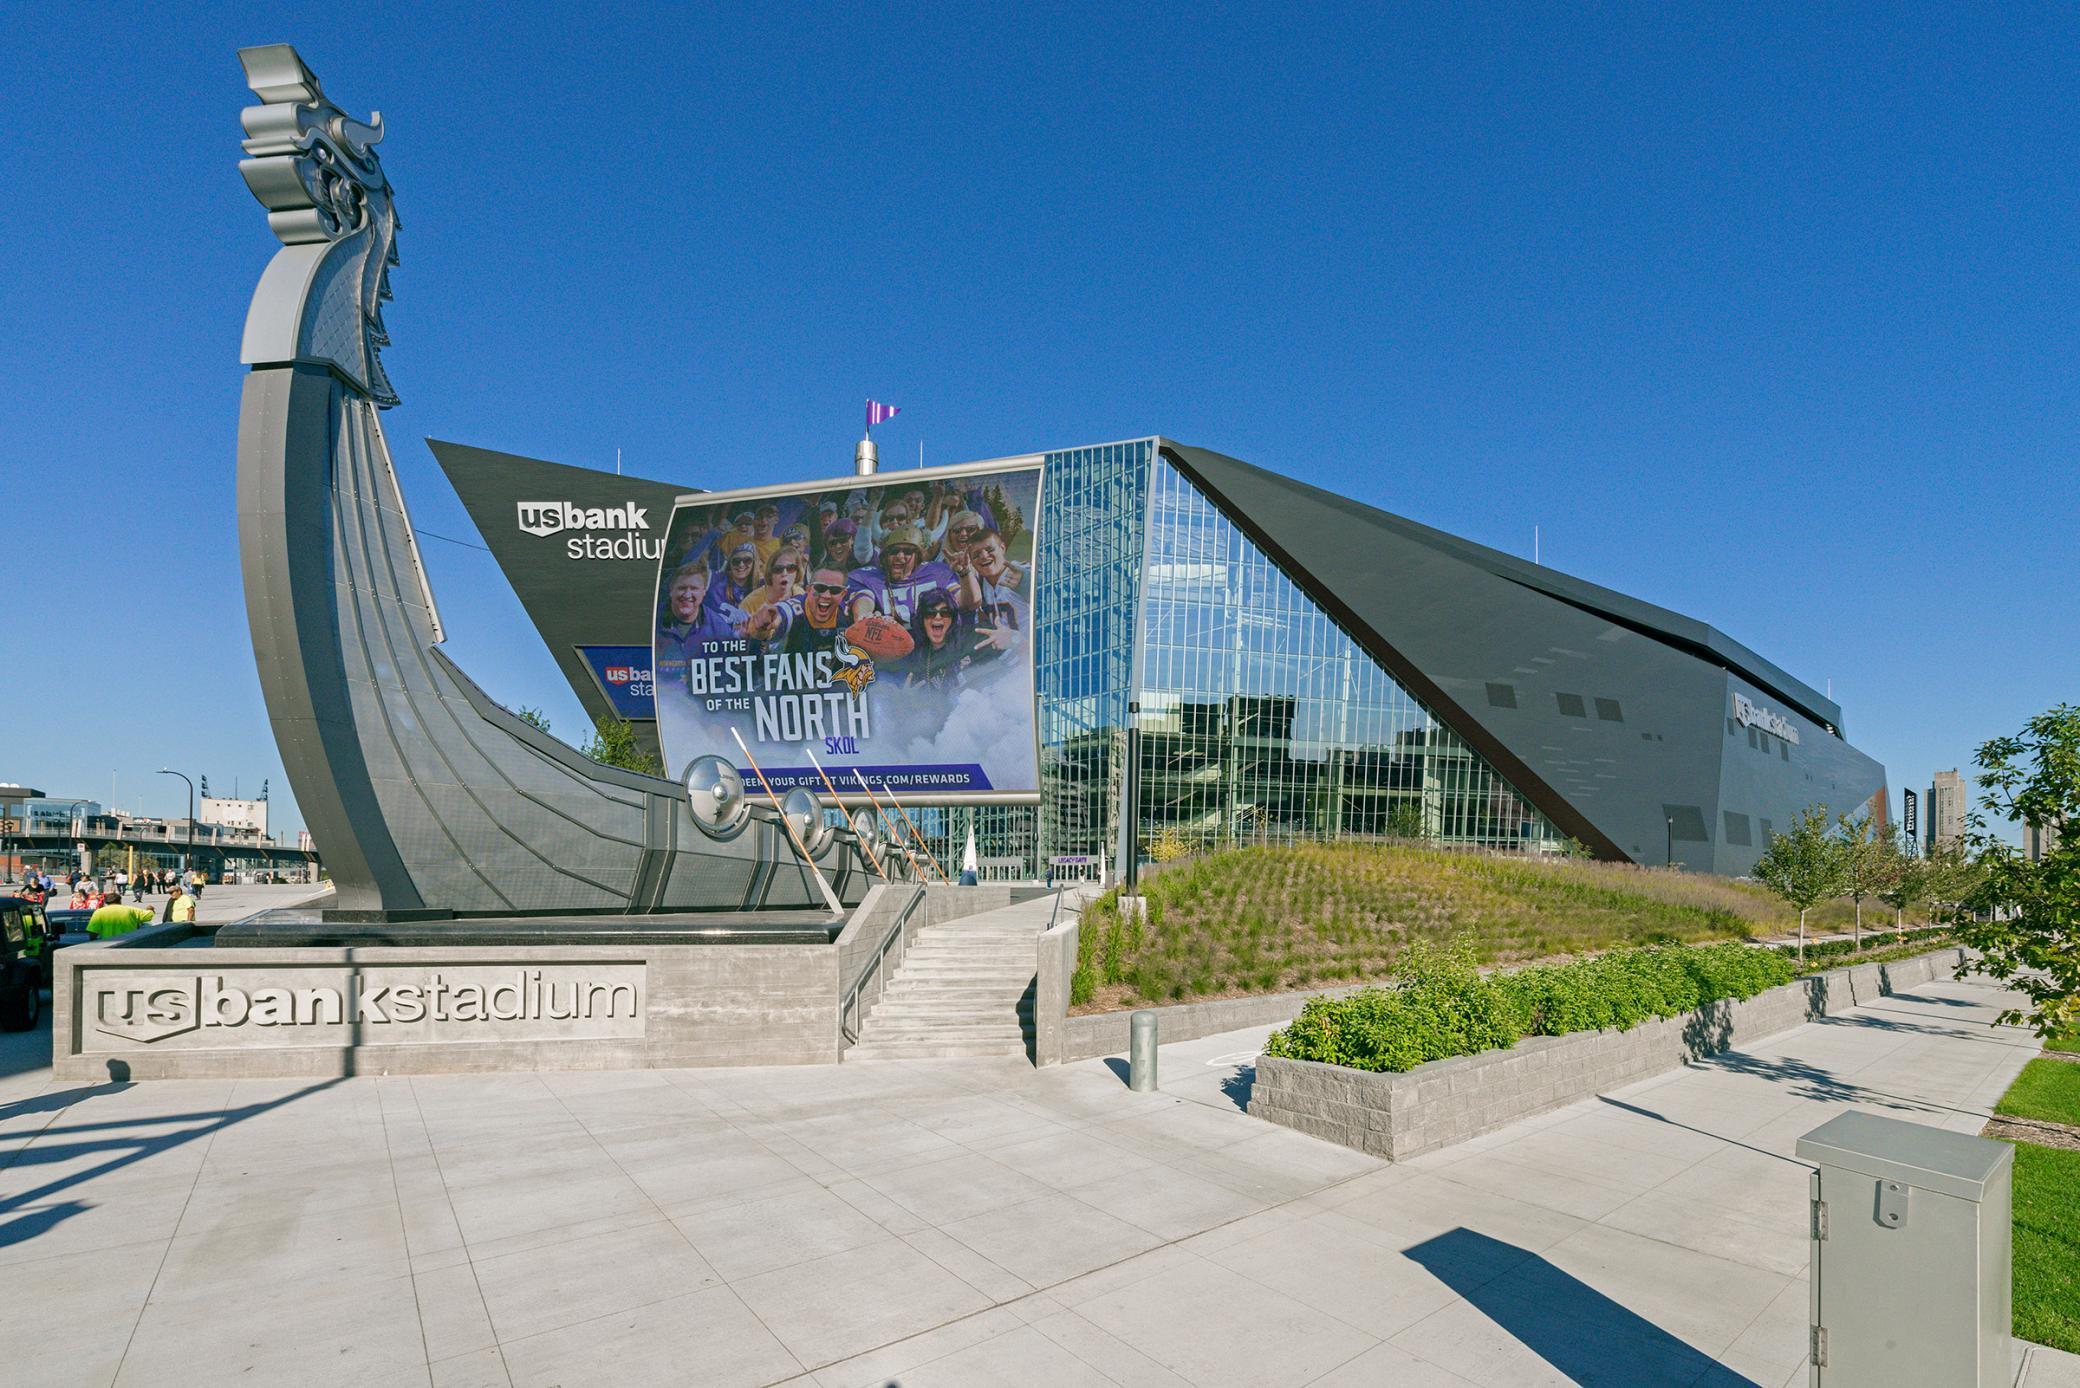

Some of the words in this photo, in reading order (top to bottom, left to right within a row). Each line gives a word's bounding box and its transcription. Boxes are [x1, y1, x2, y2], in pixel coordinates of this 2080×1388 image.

[702, 641, 718, 654] TO
[722, 639, 746, 652] THE
[691, 655, 757, 695] BEST
[764, 651, 833, 691] FANS
[706, 699, 722, 711] OF
[725, 698, 750, 710] THE
[754, 692, 870, 742] NORTH
[825, 736, 860, 755] SKOL
[768, 776, 795, 787] YOUR
[798, 775, 821, 786] GIFT
